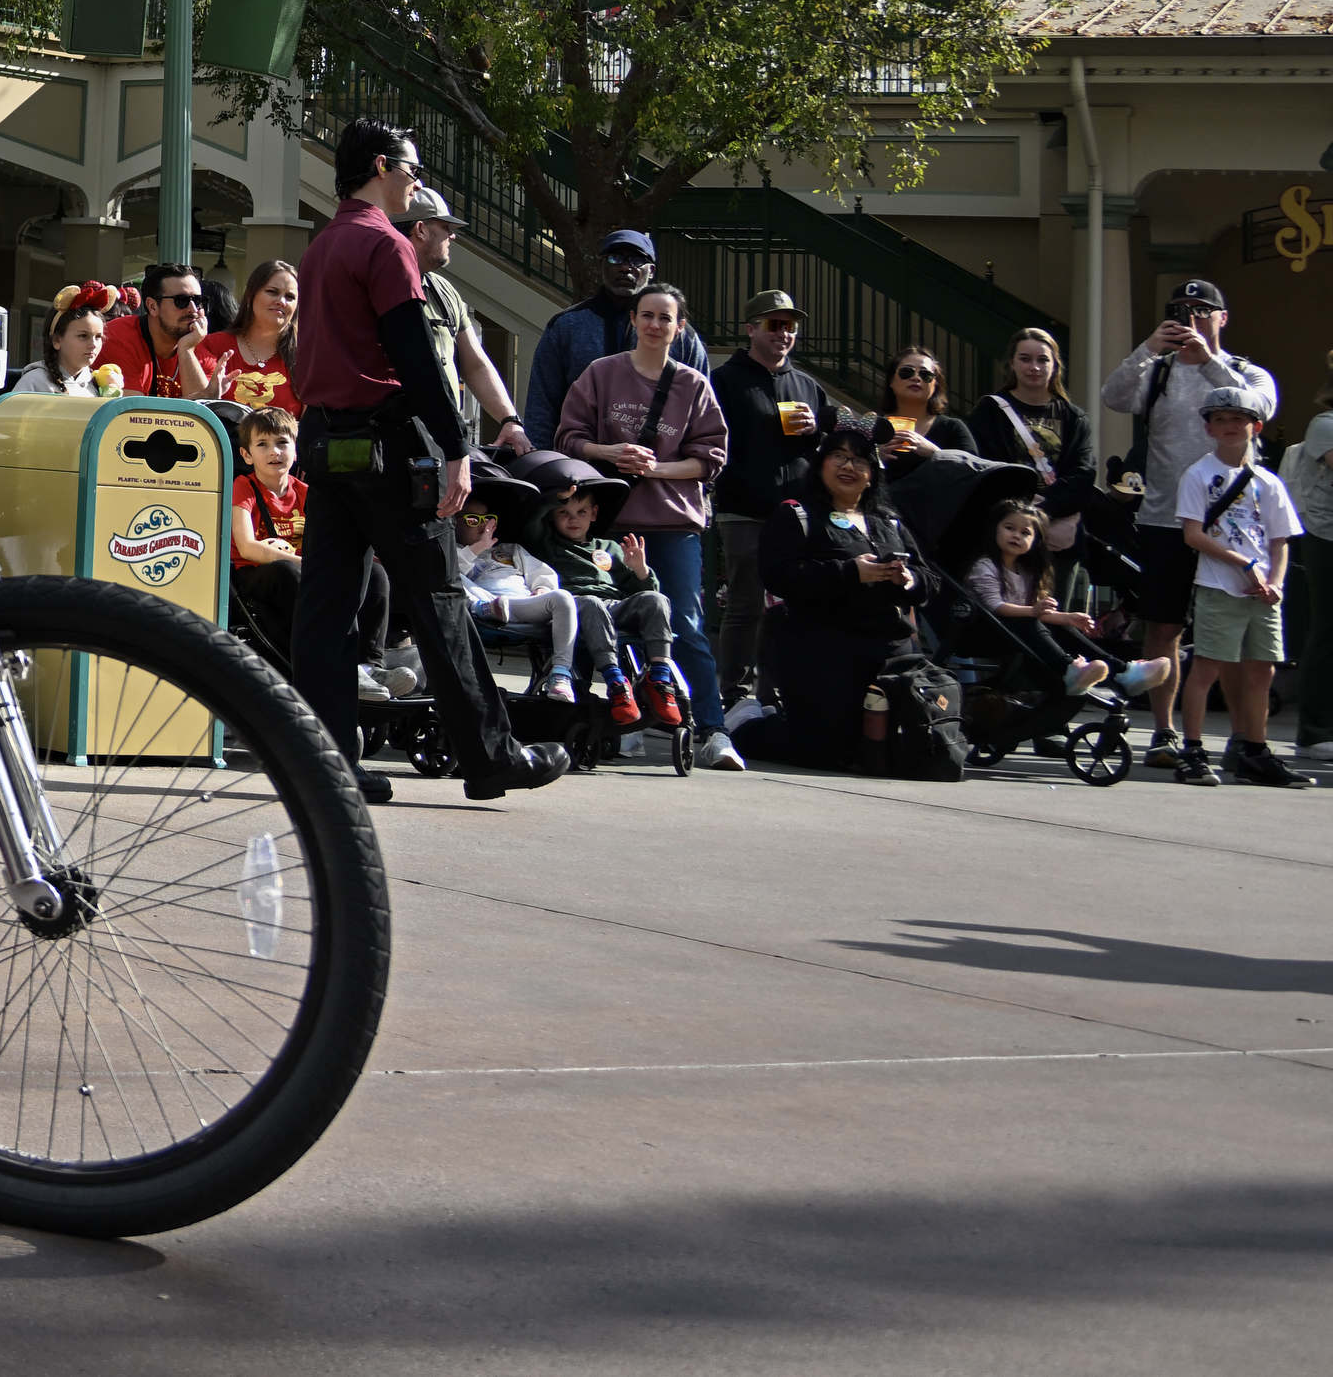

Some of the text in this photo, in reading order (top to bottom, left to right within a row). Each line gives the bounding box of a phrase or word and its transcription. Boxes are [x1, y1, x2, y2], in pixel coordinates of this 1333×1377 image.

[1186, 283, 1197, 295] C
[129, 416, 195, 428] MIXED RECYCLING
[113, 534, 200, 557] PARADISE GARDENS PARK
